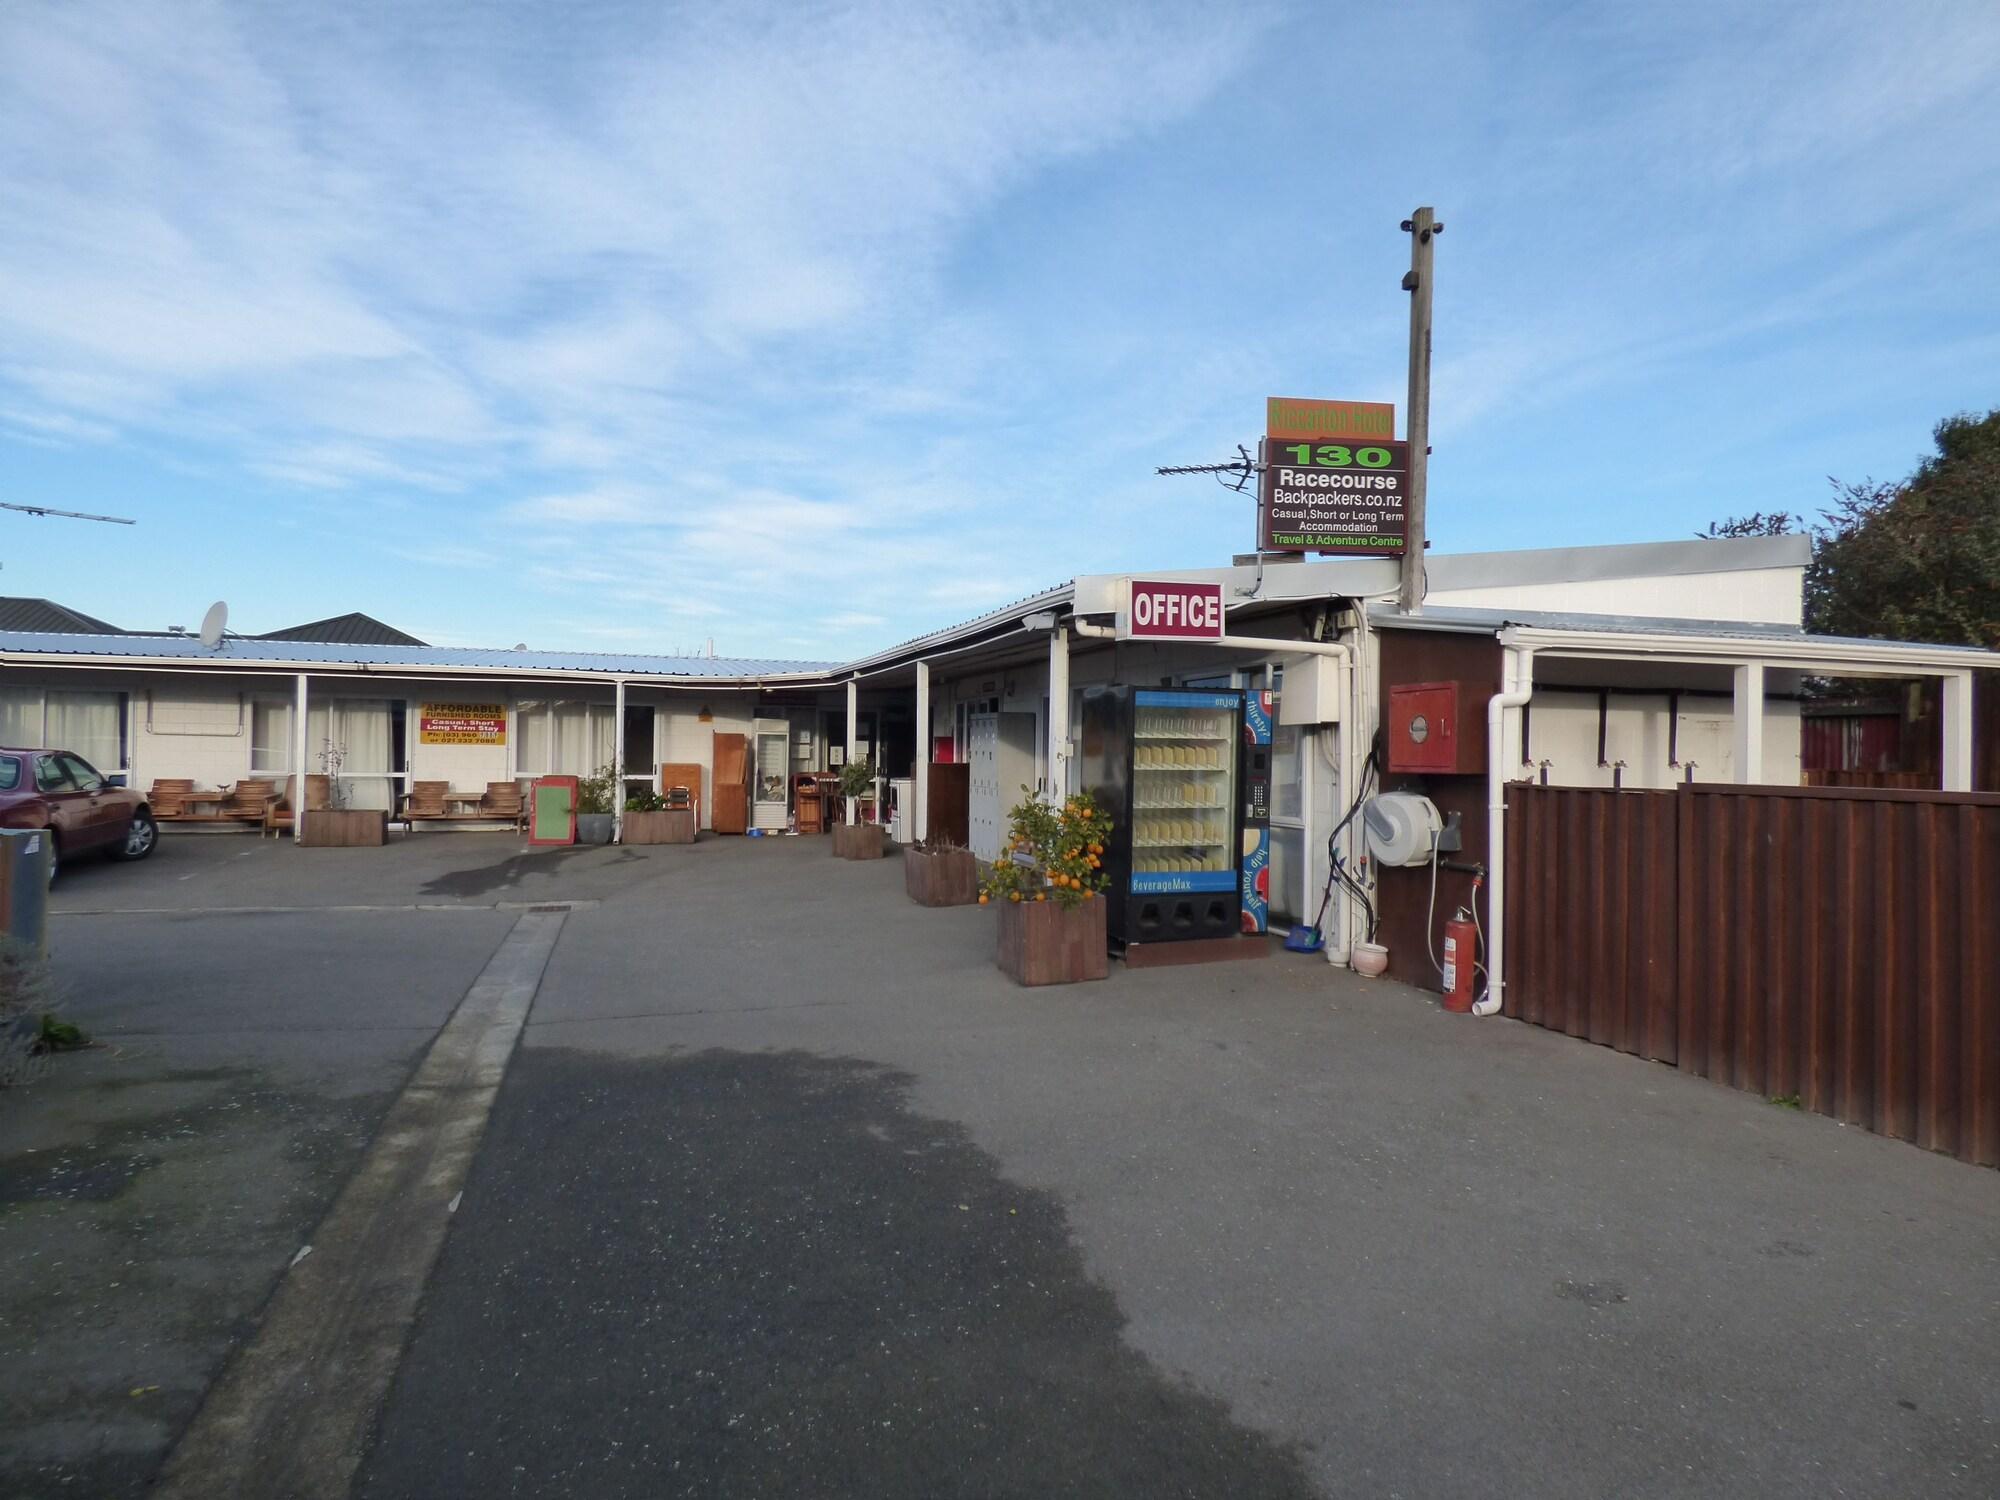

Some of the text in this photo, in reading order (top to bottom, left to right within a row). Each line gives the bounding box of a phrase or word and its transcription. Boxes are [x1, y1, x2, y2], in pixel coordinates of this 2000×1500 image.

[1286, 444, 1392, 468] 130
[1280, 469, 1397, 490] Racecourse
[1273, 488, 1403, 507] Backpackers.co.nz
[1339, 512, 1350, 520] or
[1352, 511, 1377, 523] Long
[1379, 511, 1404, 521] Term
[1299, 521, 1378, 532] Accommodation
[1272, 533, 1403, 546] Travel & Adventure Centre
[1134, 592, 1219, 628] OFFICE
[426, 704, 502, 713] AFFORDABLE
[1215, 696, 1239, 708] enjoy
[1133, 877, 1191, 893] BeverageMax
[1243, 870, 1262, 910] yourself
